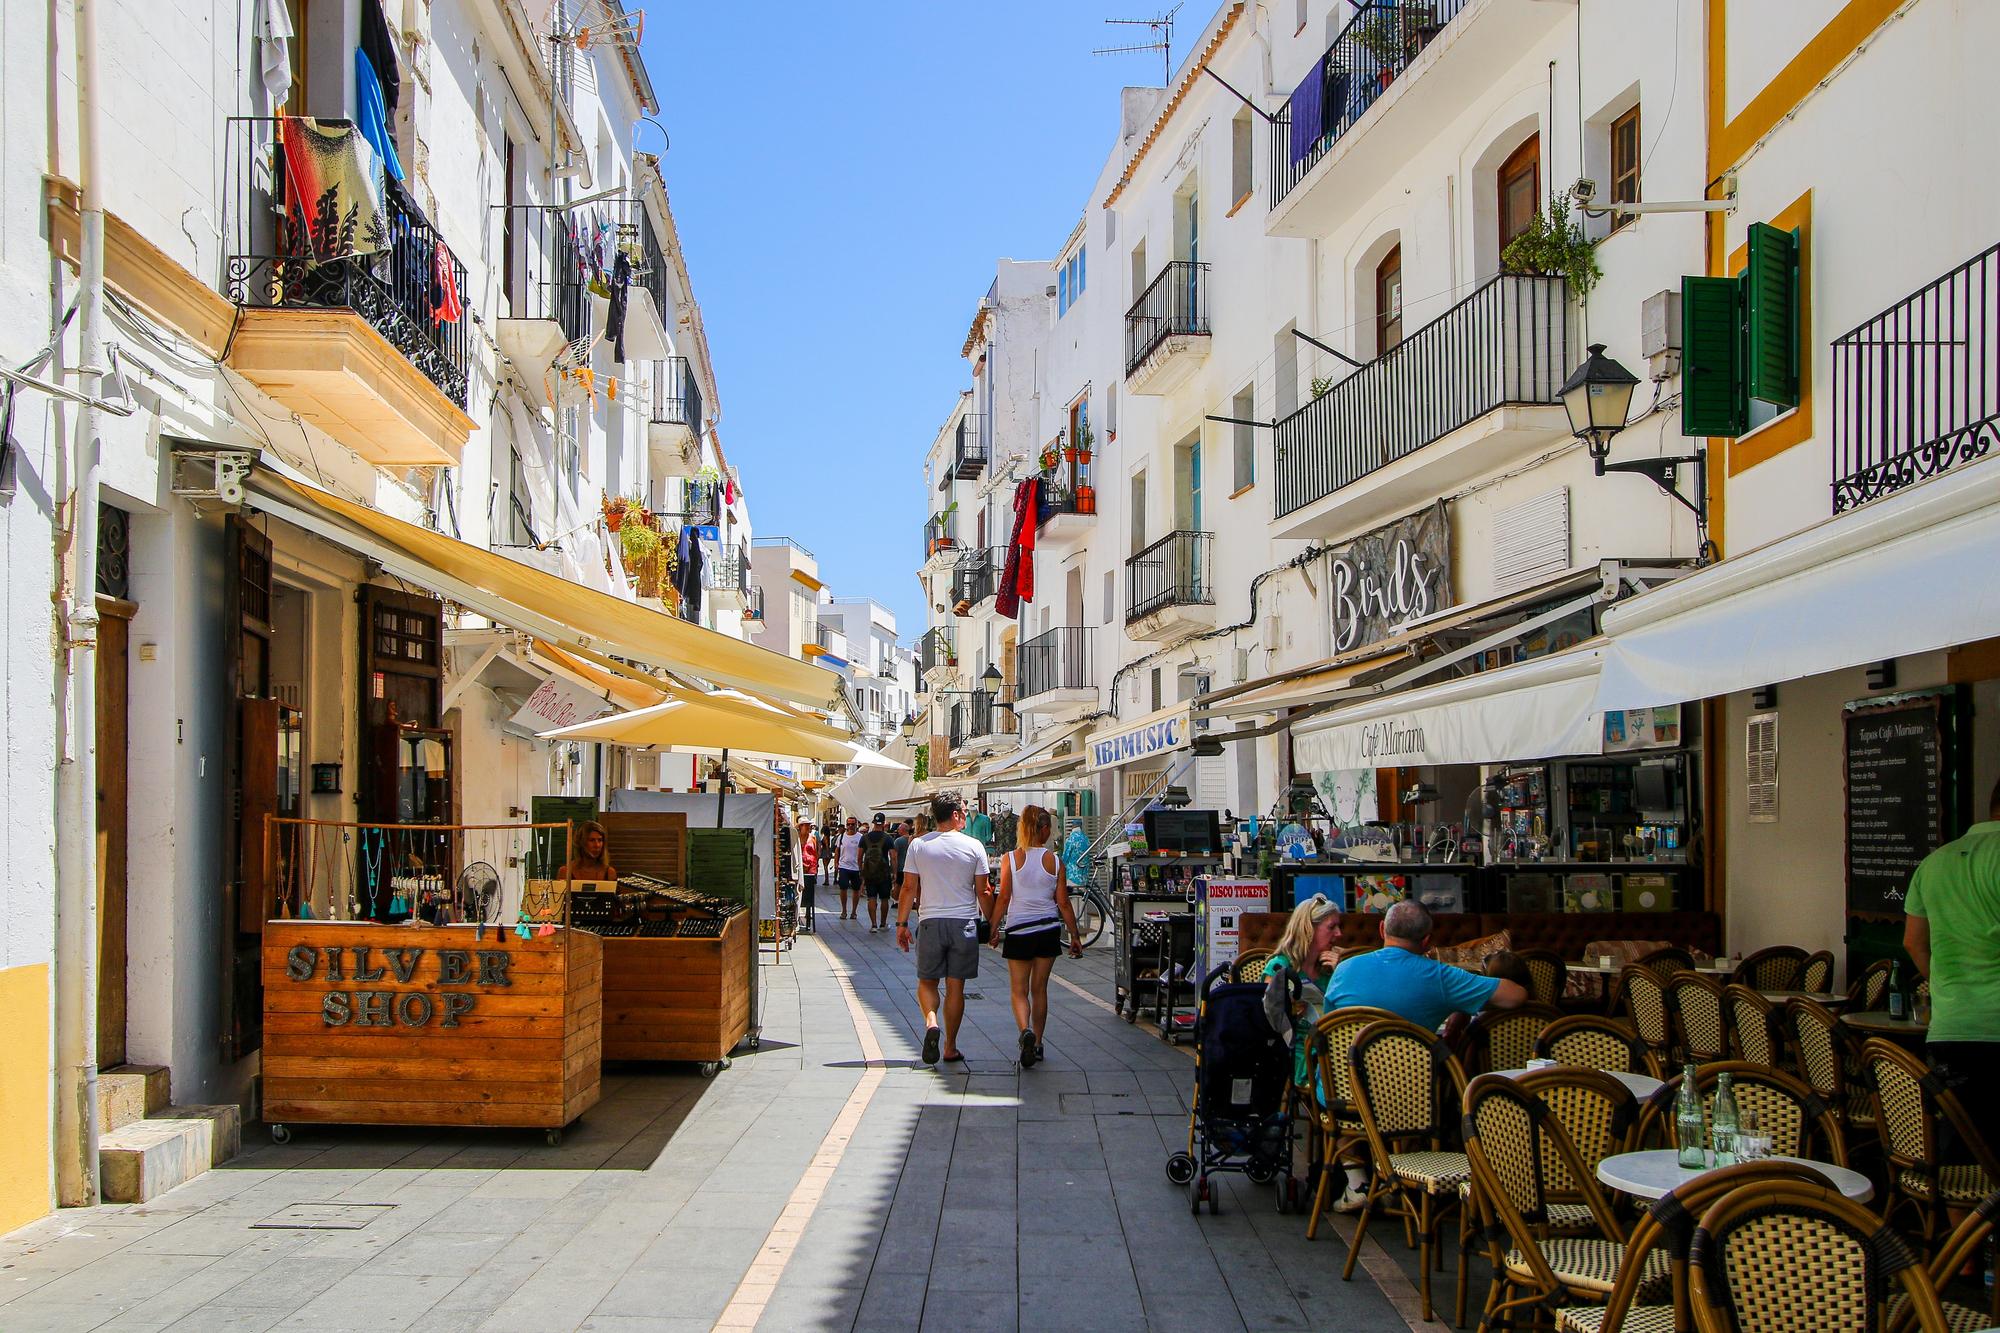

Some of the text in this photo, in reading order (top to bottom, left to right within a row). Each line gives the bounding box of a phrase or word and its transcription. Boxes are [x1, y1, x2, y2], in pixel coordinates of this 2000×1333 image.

[1333, 539, 1438, 651] Birds
[1094, 717, 1179, 767] IBIMUSIC
[1361, 720, 1425, 766] Café Mariano
[1859, 728, 1878, 743] Tapas
[1894, 723, 1923, 737] Mariano
[1209, 885, 1269, 898] DISCO TICKETS
[285, 943, 513, 987] SILVER
[320, 990, 476, 1029] SHOP
